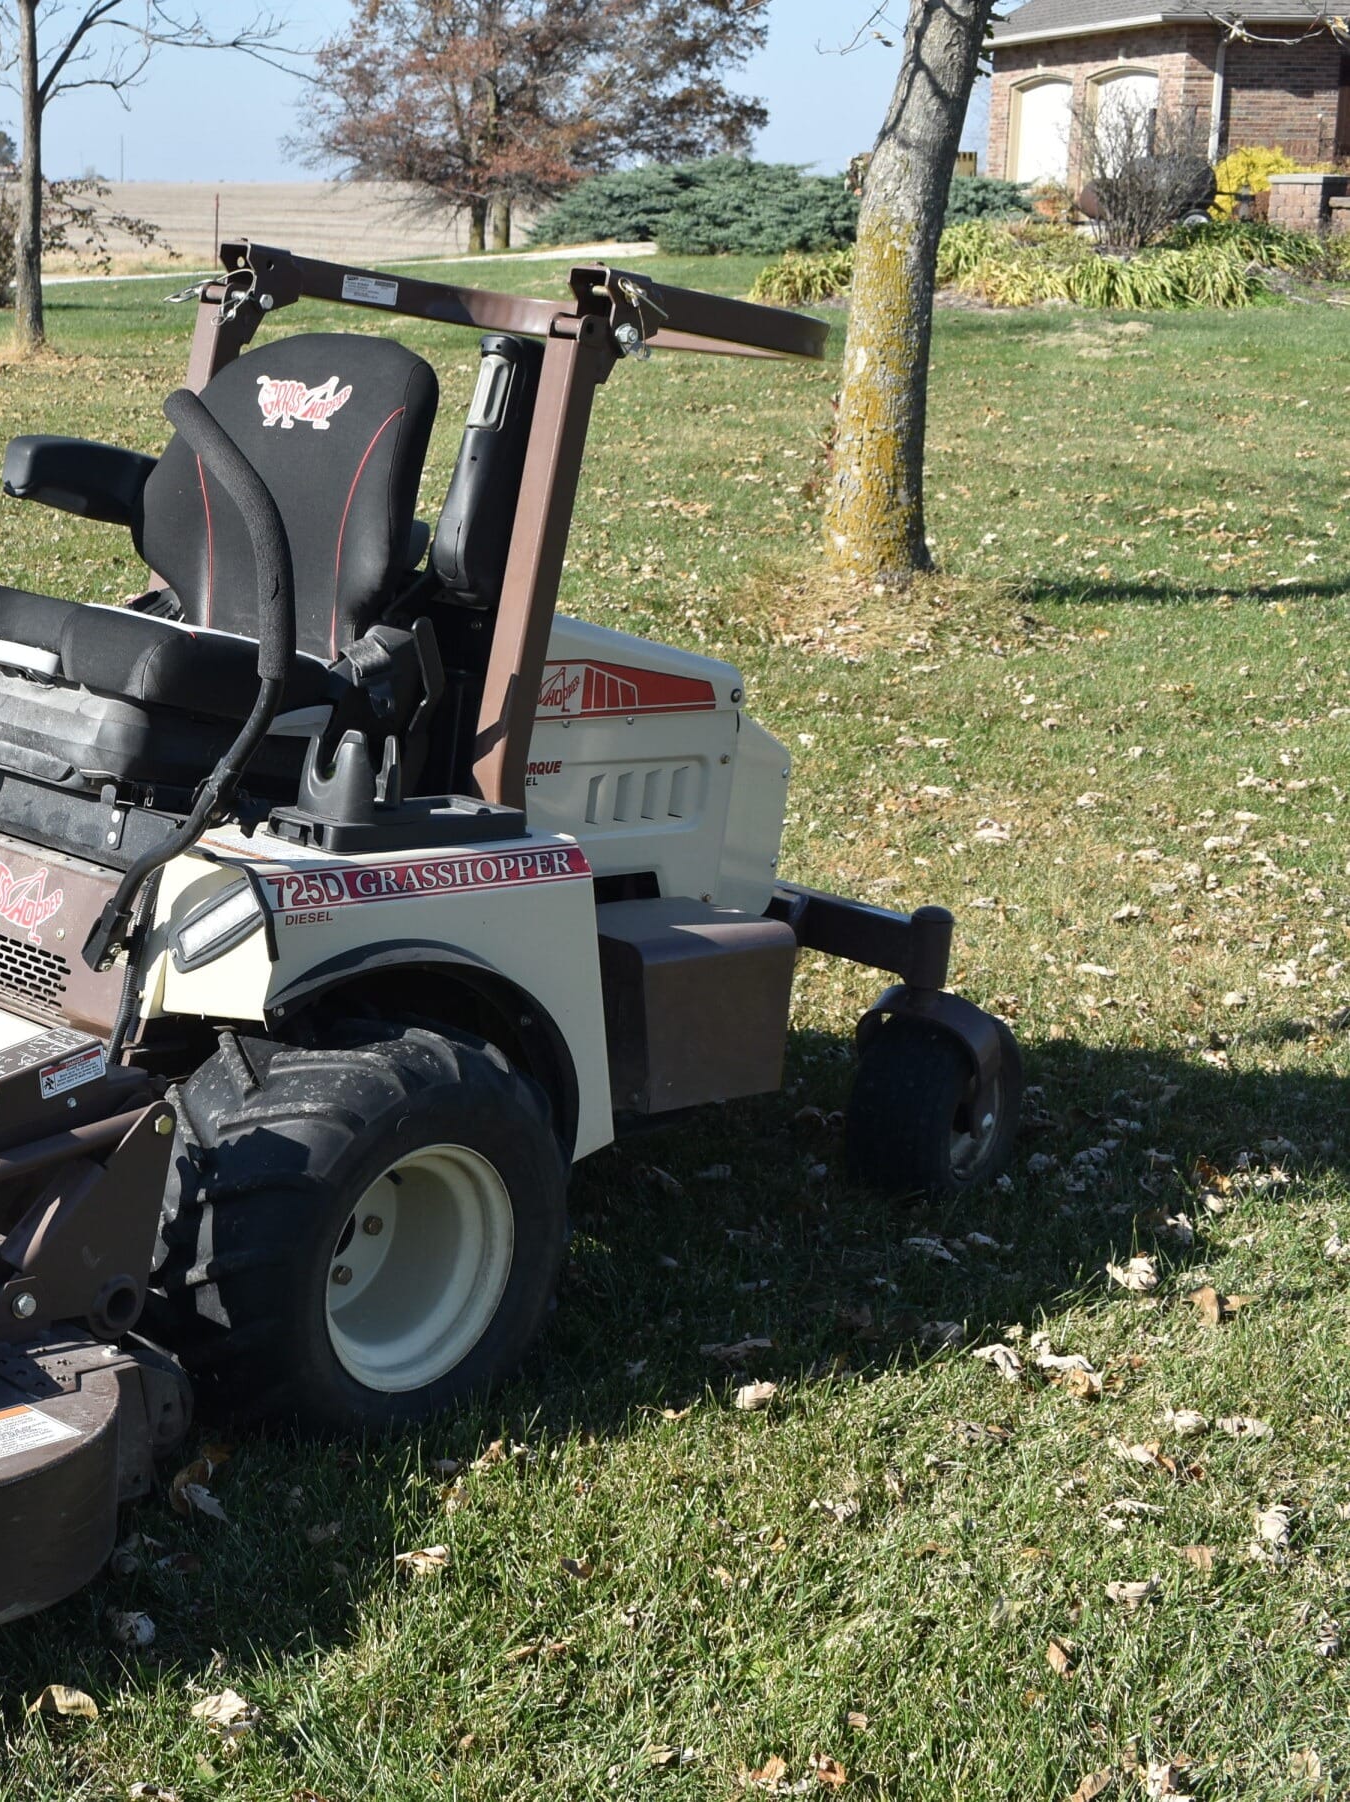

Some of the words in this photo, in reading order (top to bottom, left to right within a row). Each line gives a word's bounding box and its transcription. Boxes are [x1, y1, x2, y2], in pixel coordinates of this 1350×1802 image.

[266, 872, 345, 908] 725D
[354, 850, 573, 897] GRASSHOPPER
[284, 911, 334, 927] DIESEL
